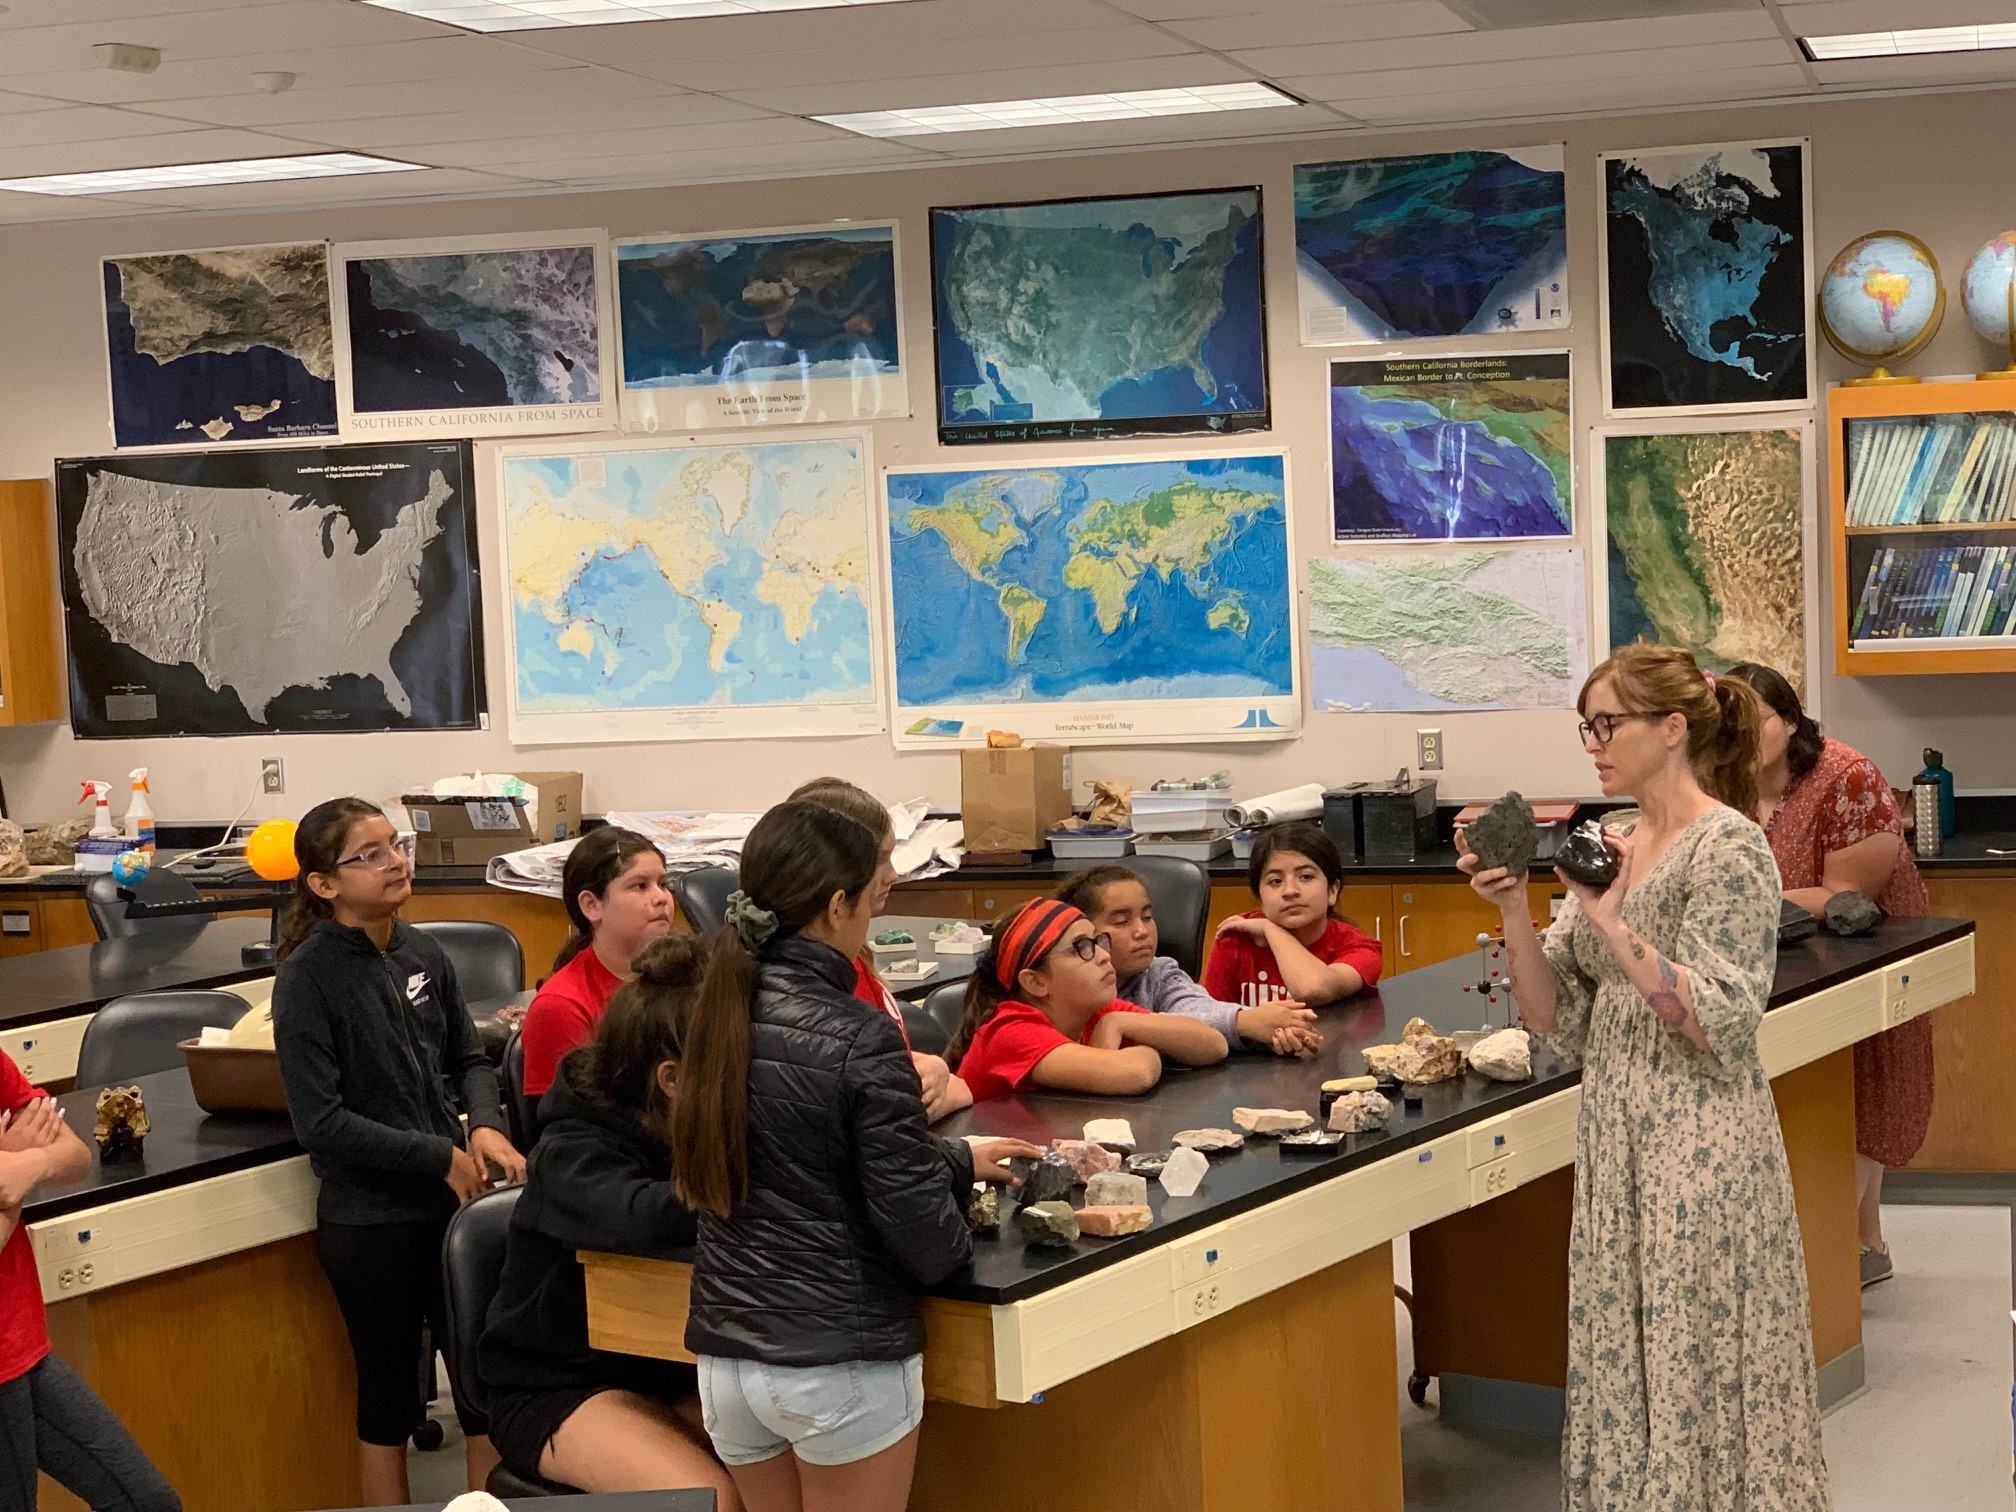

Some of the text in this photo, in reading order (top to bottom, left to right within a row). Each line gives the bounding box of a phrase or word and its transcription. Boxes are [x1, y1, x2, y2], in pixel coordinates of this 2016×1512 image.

[1385, 359, 1508, 371] Southern California Borderlands:
[1383, 374, 1415, 382] Mexican
[1417, 373, 1443, 381] Border
[1467, 371, 1511, 380] Conception
[717, 393, 807, 405] The Earth From Space
[351, 407, 605, 430] SOUTHERN CALIFORNIA FROM SPACE
[312, 422, 337, 430] Channel
[1020, 427, 1028, 440] of
[1096, 722, 1117, 730] World
[1118, 721, 1134, 731] Map
